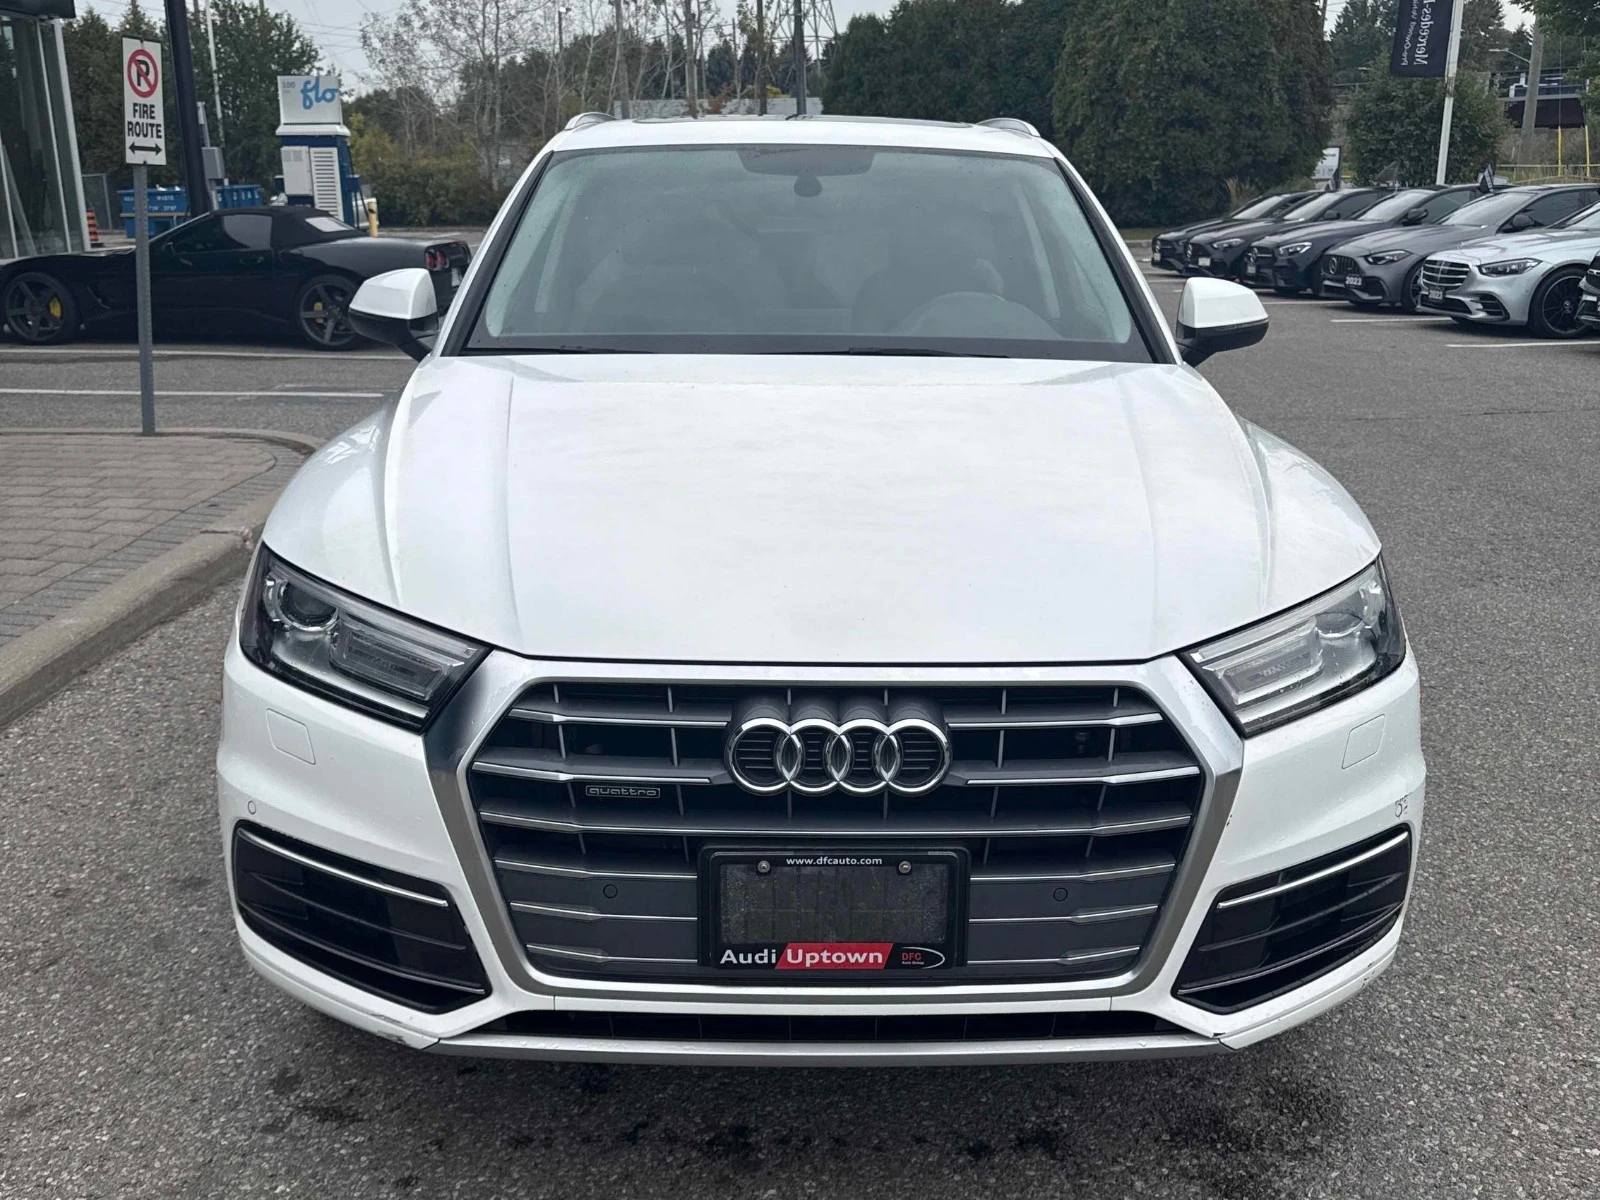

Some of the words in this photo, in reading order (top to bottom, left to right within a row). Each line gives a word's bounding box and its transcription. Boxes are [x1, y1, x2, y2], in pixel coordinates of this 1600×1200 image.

[301, 76, 341, 110] flo
[132, 102, 156, 120] FIRE
[127, 121, 163, 139] ROUTE
[1345, 276, 1362, 286] 2023
[589, 787, 657, 796] quattro
[786, 856, 883, 865] www.dfcauto.com
[720, 949, 777, 964] Audi
[786, 949, 884, 967] Uptown
[901, 952, 922, 961] DFC
